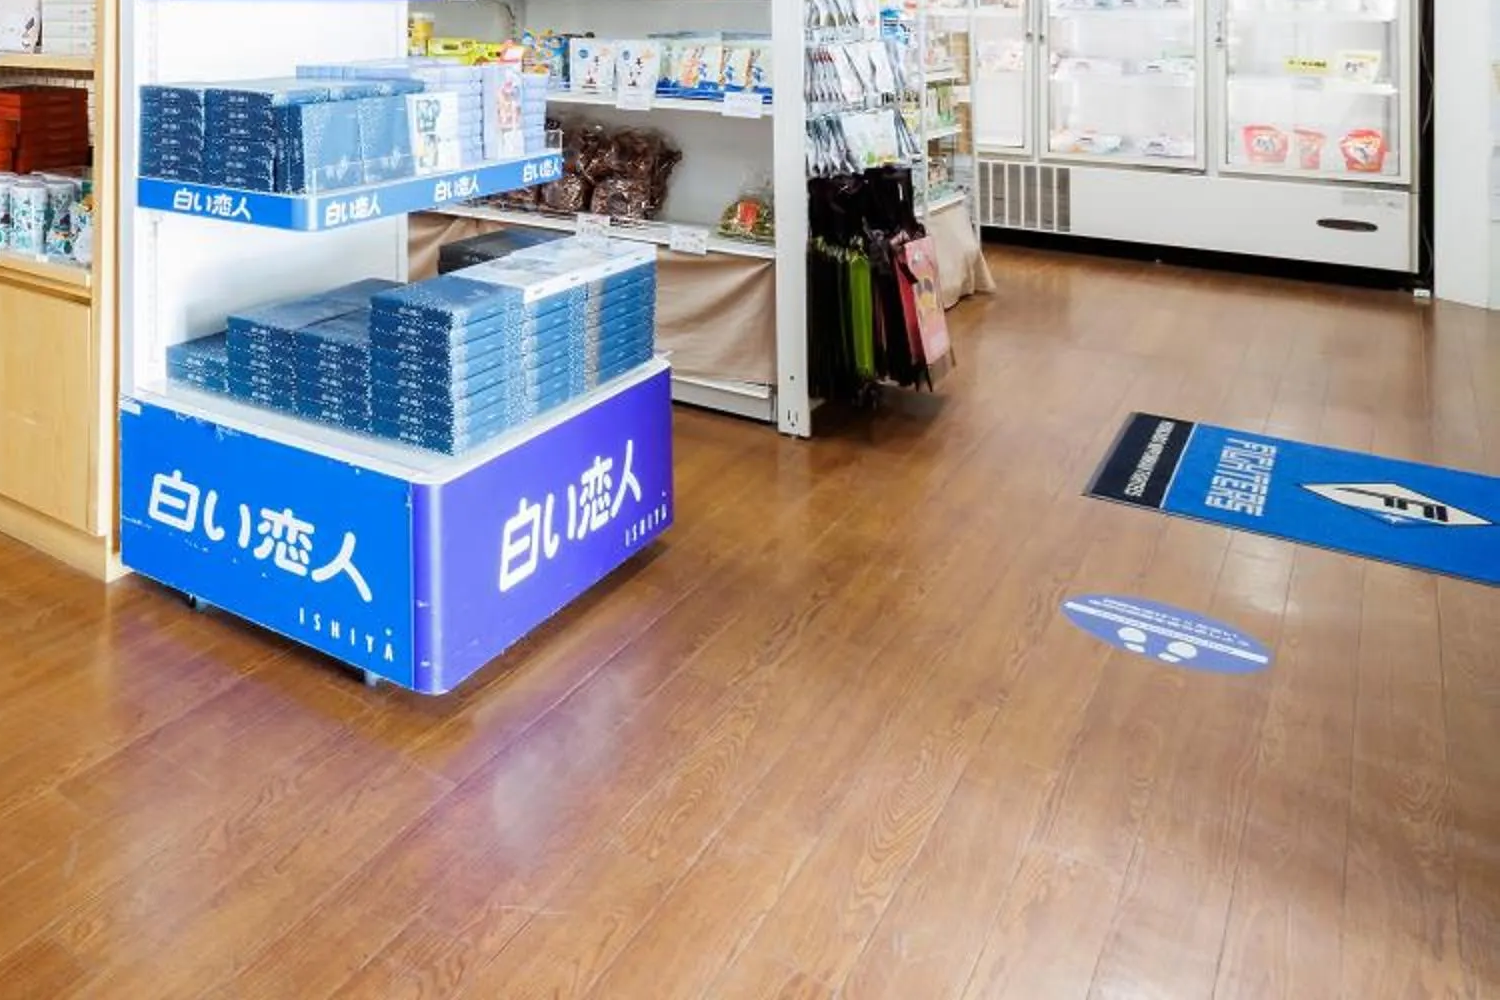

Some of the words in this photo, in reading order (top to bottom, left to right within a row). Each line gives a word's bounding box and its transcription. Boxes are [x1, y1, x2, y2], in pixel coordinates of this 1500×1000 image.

[522, 155, 562, 184] 白い恋人
[434, 174, 480, 203] 白い恋人
[173, 189, 253, 222] 白い恋人
[325, 194, 382, 226] 白い恋人
[499, 439, 642, 592] 白い恋人
[148, 469, 373, 603] 白い恋人
[299, 607, 393, 662] ISHIYA
